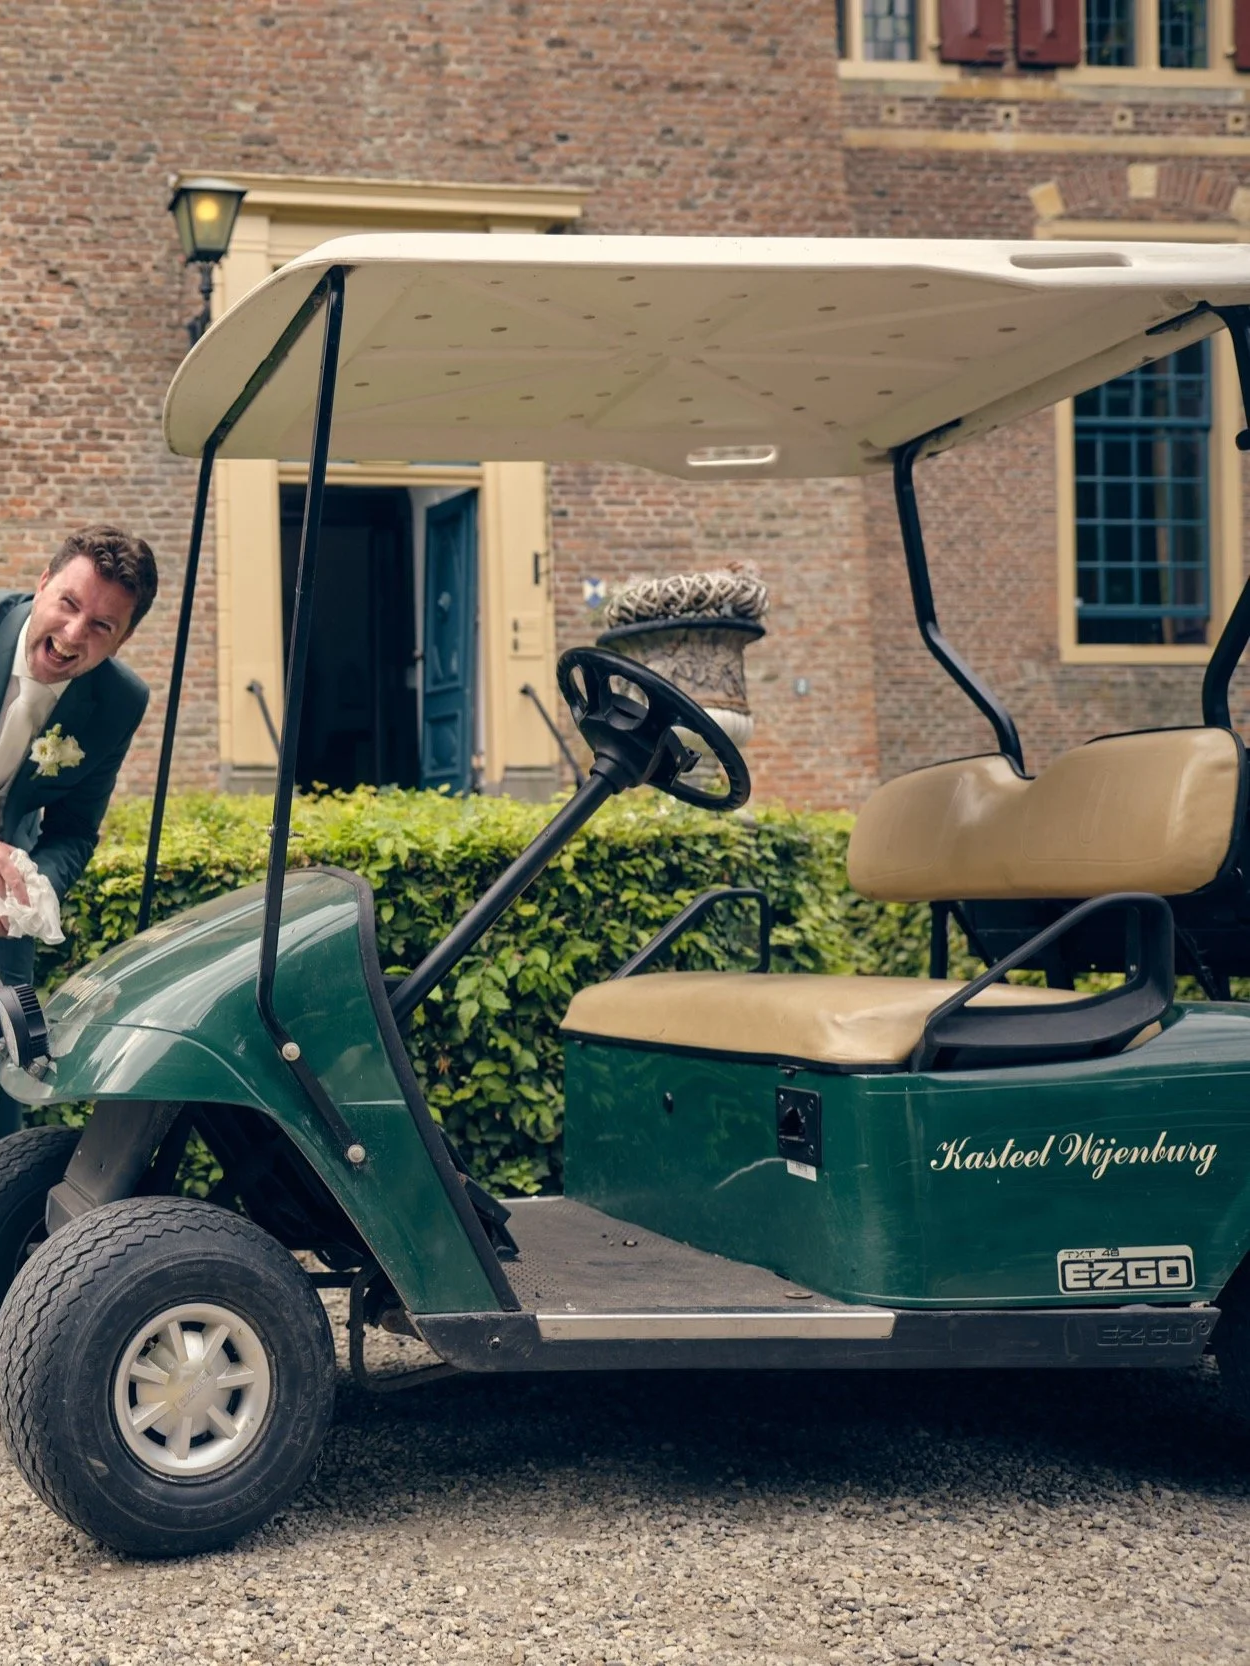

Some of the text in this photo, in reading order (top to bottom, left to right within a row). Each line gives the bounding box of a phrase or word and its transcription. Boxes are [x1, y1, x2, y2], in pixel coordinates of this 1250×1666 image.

[930, 1131, 1218, 1180] Kasteel Wijenburg
[1064, 1248, 1120, 1259] TXT 48
[1064, 1259, 1188, 1289] EZGO
[1096, 1324, 1194, 1347] EZGO
